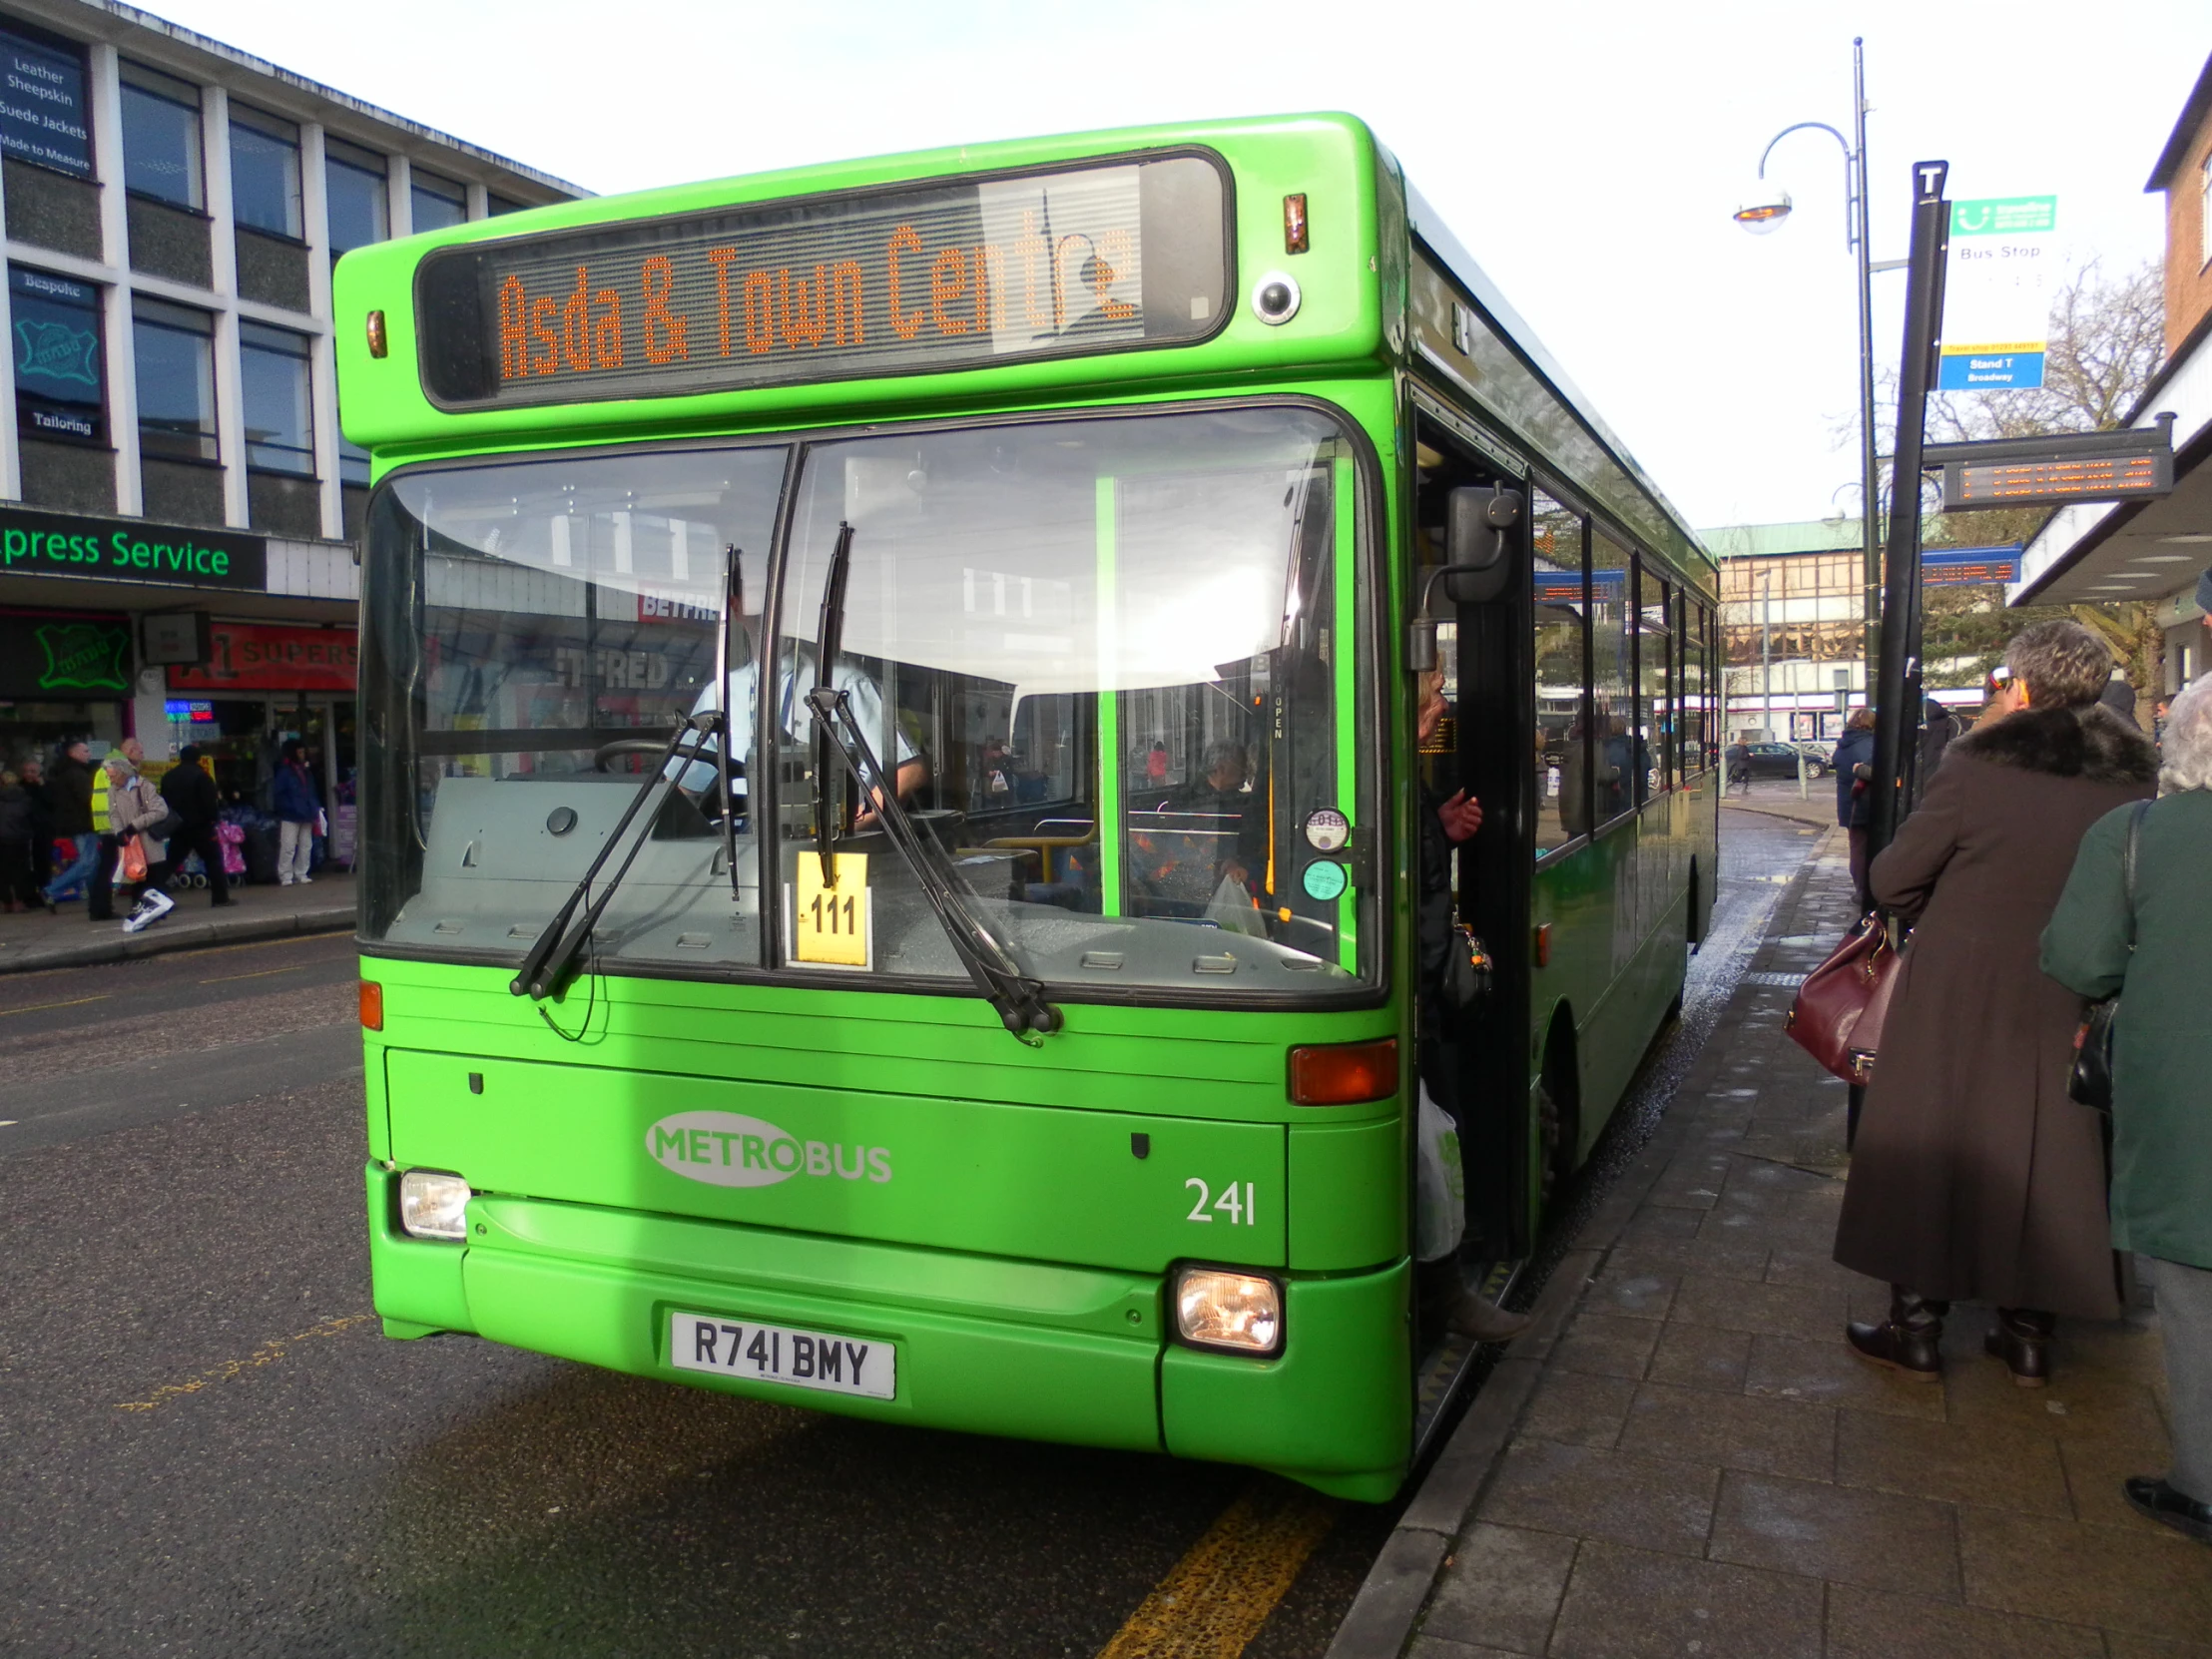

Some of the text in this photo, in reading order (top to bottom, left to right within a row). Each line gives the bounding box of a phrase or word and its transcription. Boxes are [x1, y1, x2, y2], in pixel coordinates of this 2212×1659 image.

[14, 58, 64, 84] Leather
[7, 75, 73, 107] Sheepskin
[0, 101, 88, 140] Suede Jackets
[0, 133, 91, 171] Made to Measure
[1919, 168, 1941, 194] T
[1960, 246, 2040, 261] Bus Stop
[24, 274, 81, 297] Bespoke
[499, 208, 1136, 378] Asda & Town Centre
[1967, 372, 2013, 383] Broadway
[1969, 357, 2013, 369] Stand T
[33, 412, 92, 435] Tailoring
[4, 527, 230, 576] press Service
[1274, 697, 1283, 739] OPEN
[812, 893, 854, 935] 111
[654, 1125, 893, 1184] METROBUS
[1184, 1177, 1255, 1226] 241
[695, 1321, 868, 1385] R741 BMY
